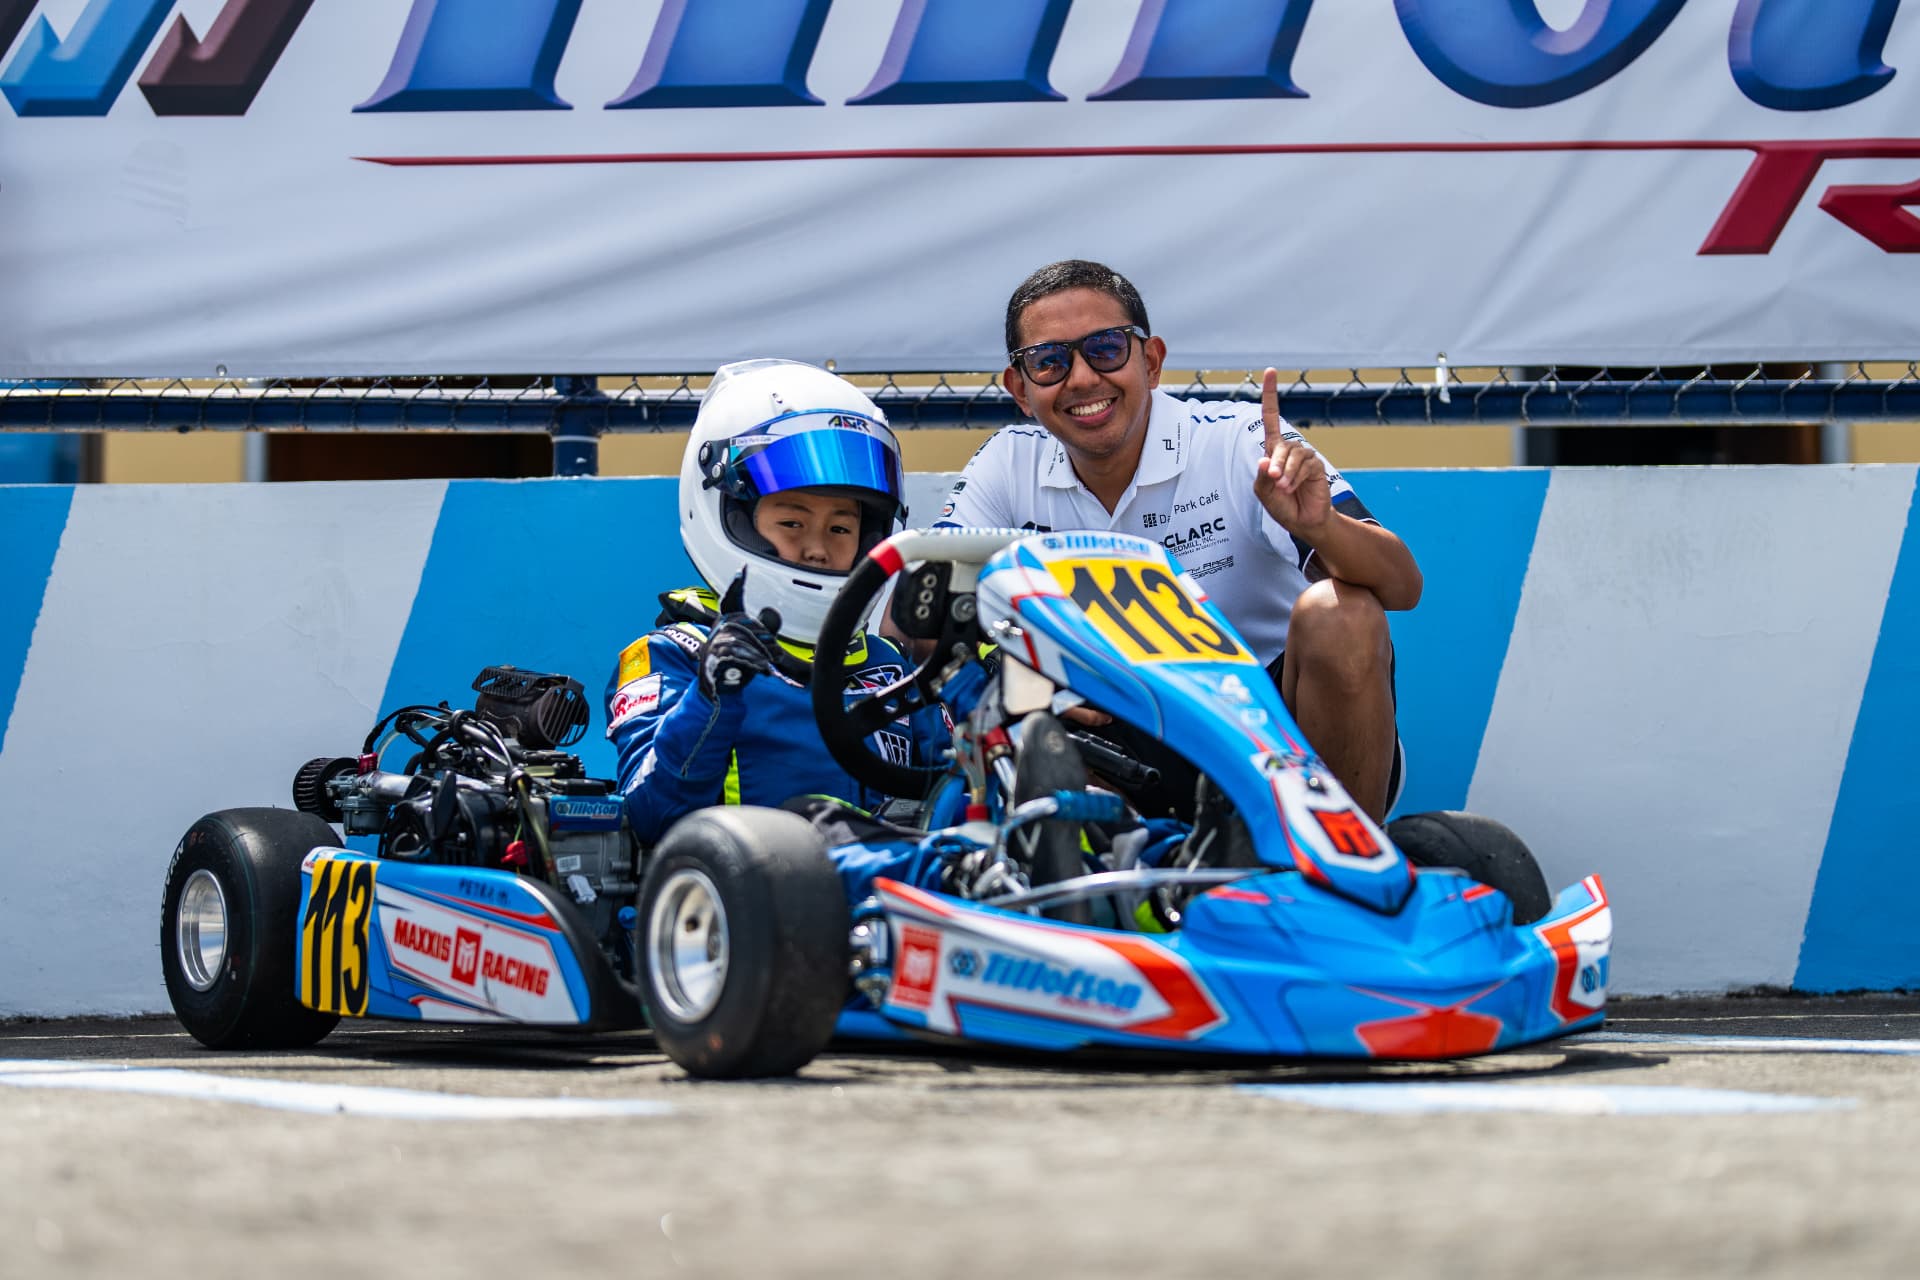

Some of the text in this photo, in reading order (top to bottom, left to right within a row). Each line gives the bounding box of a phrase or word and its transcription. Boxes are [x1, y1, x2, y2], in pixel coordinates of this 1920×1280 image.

[1163, 517, 1226, 549] CLARC
[1173, 489, 1220, 515] Park Café
[1069, 566, 1240, 656] 113
[303, 860, 372, 1016] 113
[393, 917, 550, 998] MAXXIS RACING
